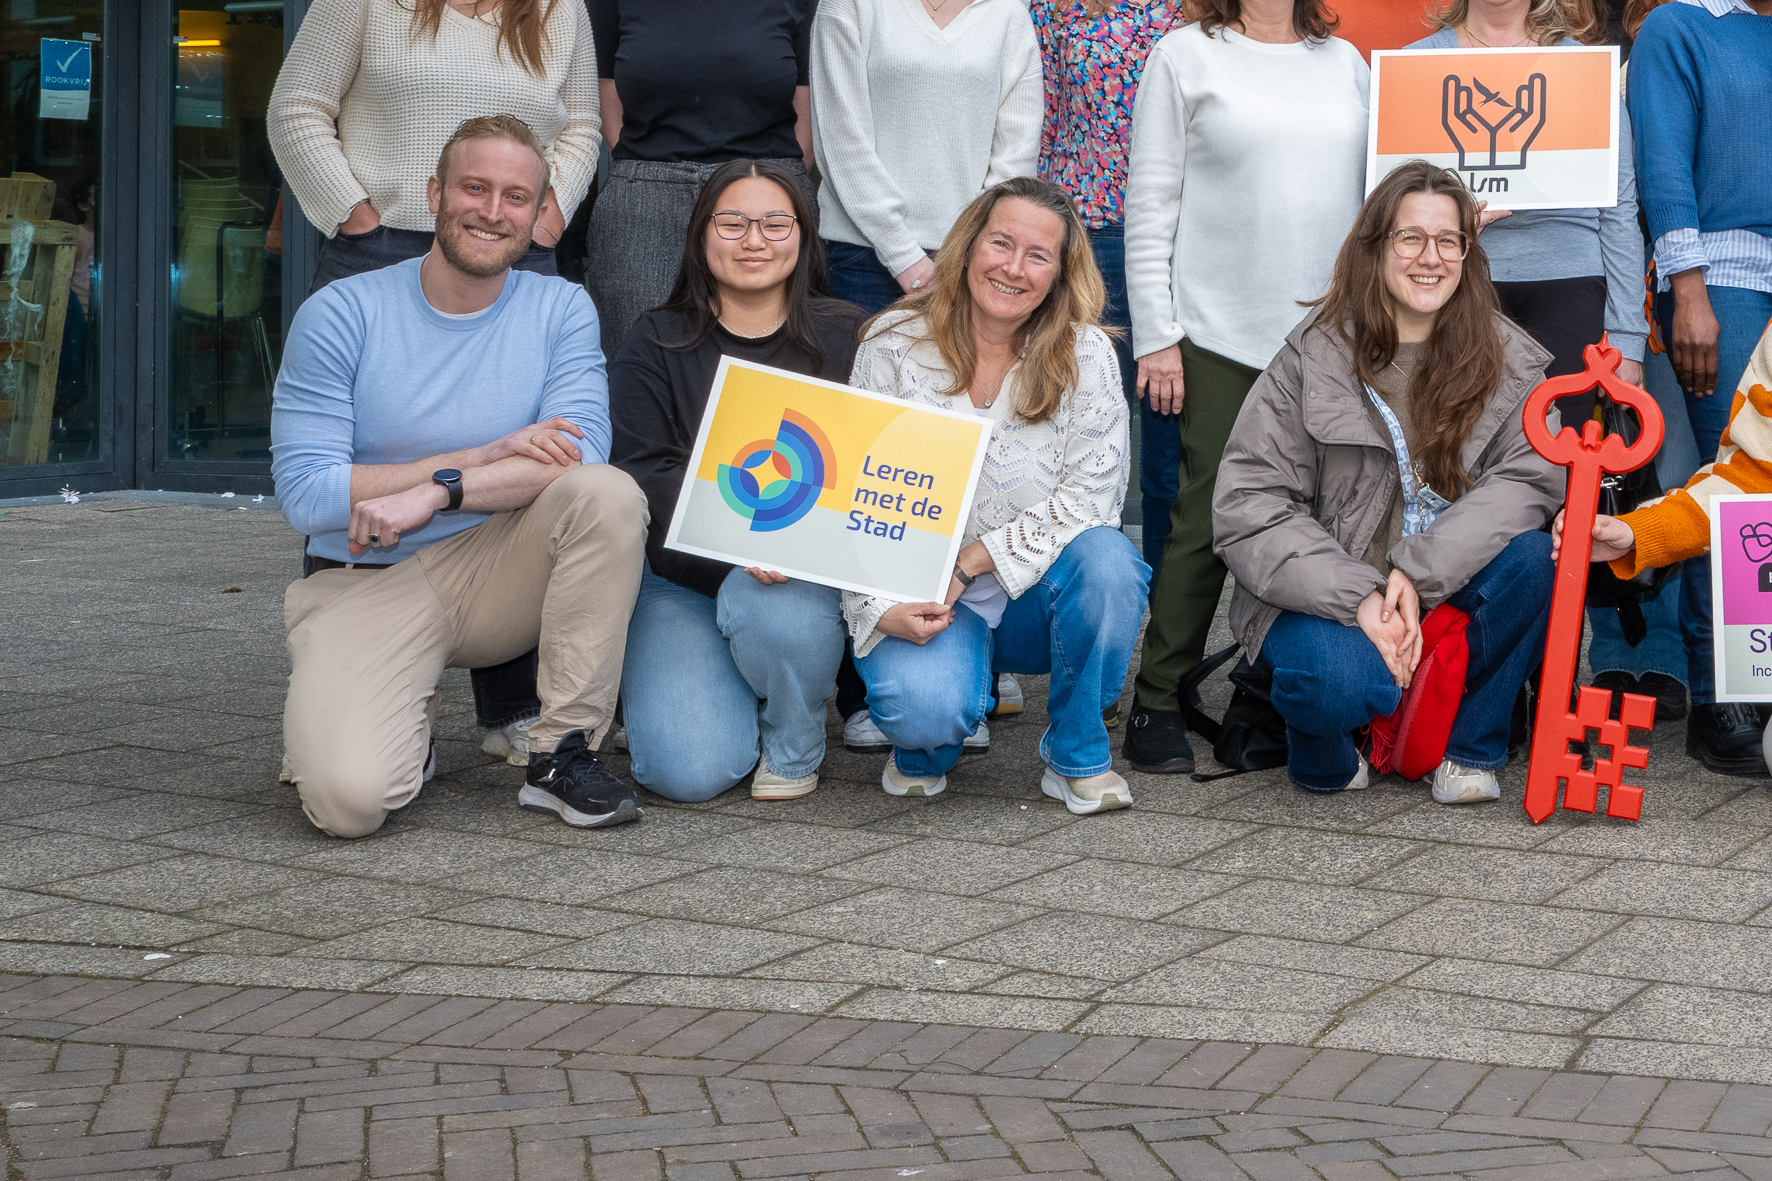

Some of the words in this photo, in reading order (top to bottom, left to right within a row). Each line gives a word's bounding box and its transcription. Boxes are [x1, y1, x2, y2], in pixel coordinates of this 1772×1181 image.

[45, 75, 88, 86] ROOKVRIJ
[862, 455, 934, 490] Leren
[854, 487, 906, 513] met
[911, 497, 943, 521] de
[846, 509, 907, 542] Stad
